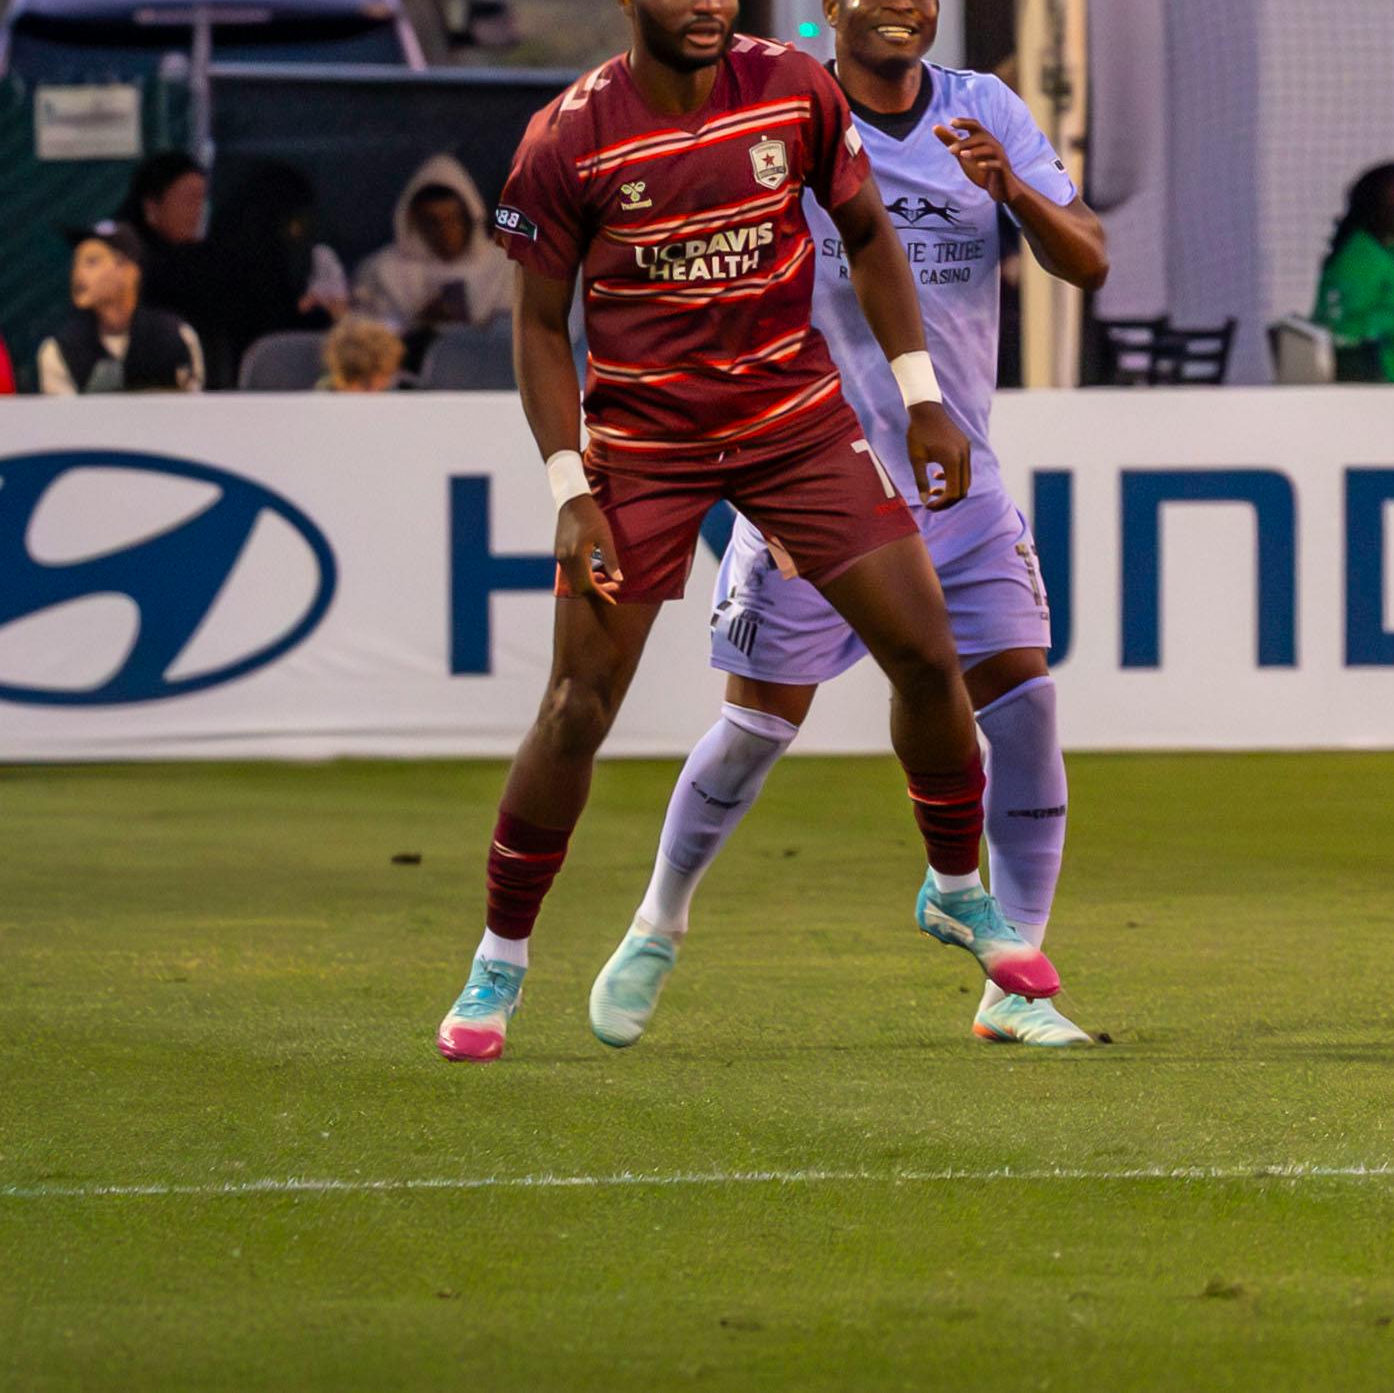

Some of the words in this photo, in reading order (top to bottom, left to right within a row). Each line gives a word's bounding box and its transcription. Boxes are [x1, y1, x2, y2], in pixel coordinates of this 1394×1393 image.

[933, 238, 986, 263] TRIBE
[650, 251, 759, 282] HEALTH
[919, 266, 972, 285] CASINO
